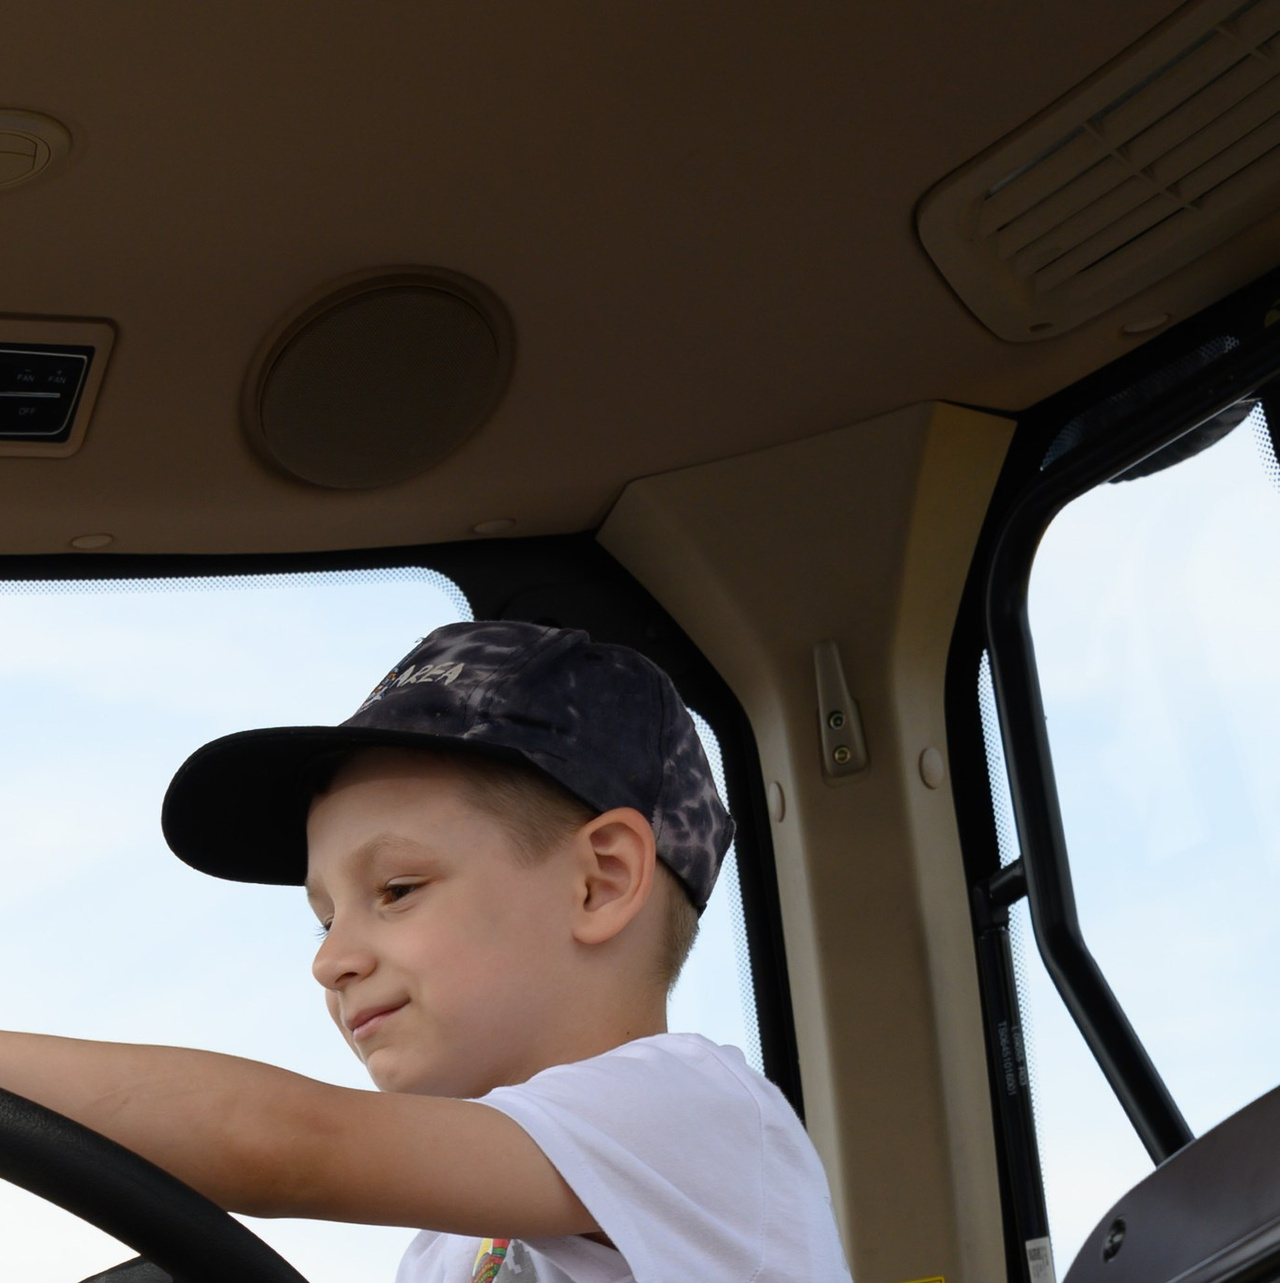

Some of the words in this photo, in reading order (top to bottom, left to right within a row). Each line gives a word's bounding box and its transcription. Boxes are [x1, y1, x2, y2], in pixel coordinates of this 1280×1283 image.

[17, 373, 36, 383] FAN
[48, 375, 67, 385] FAN
[18, 406, 37, 416] OFF
